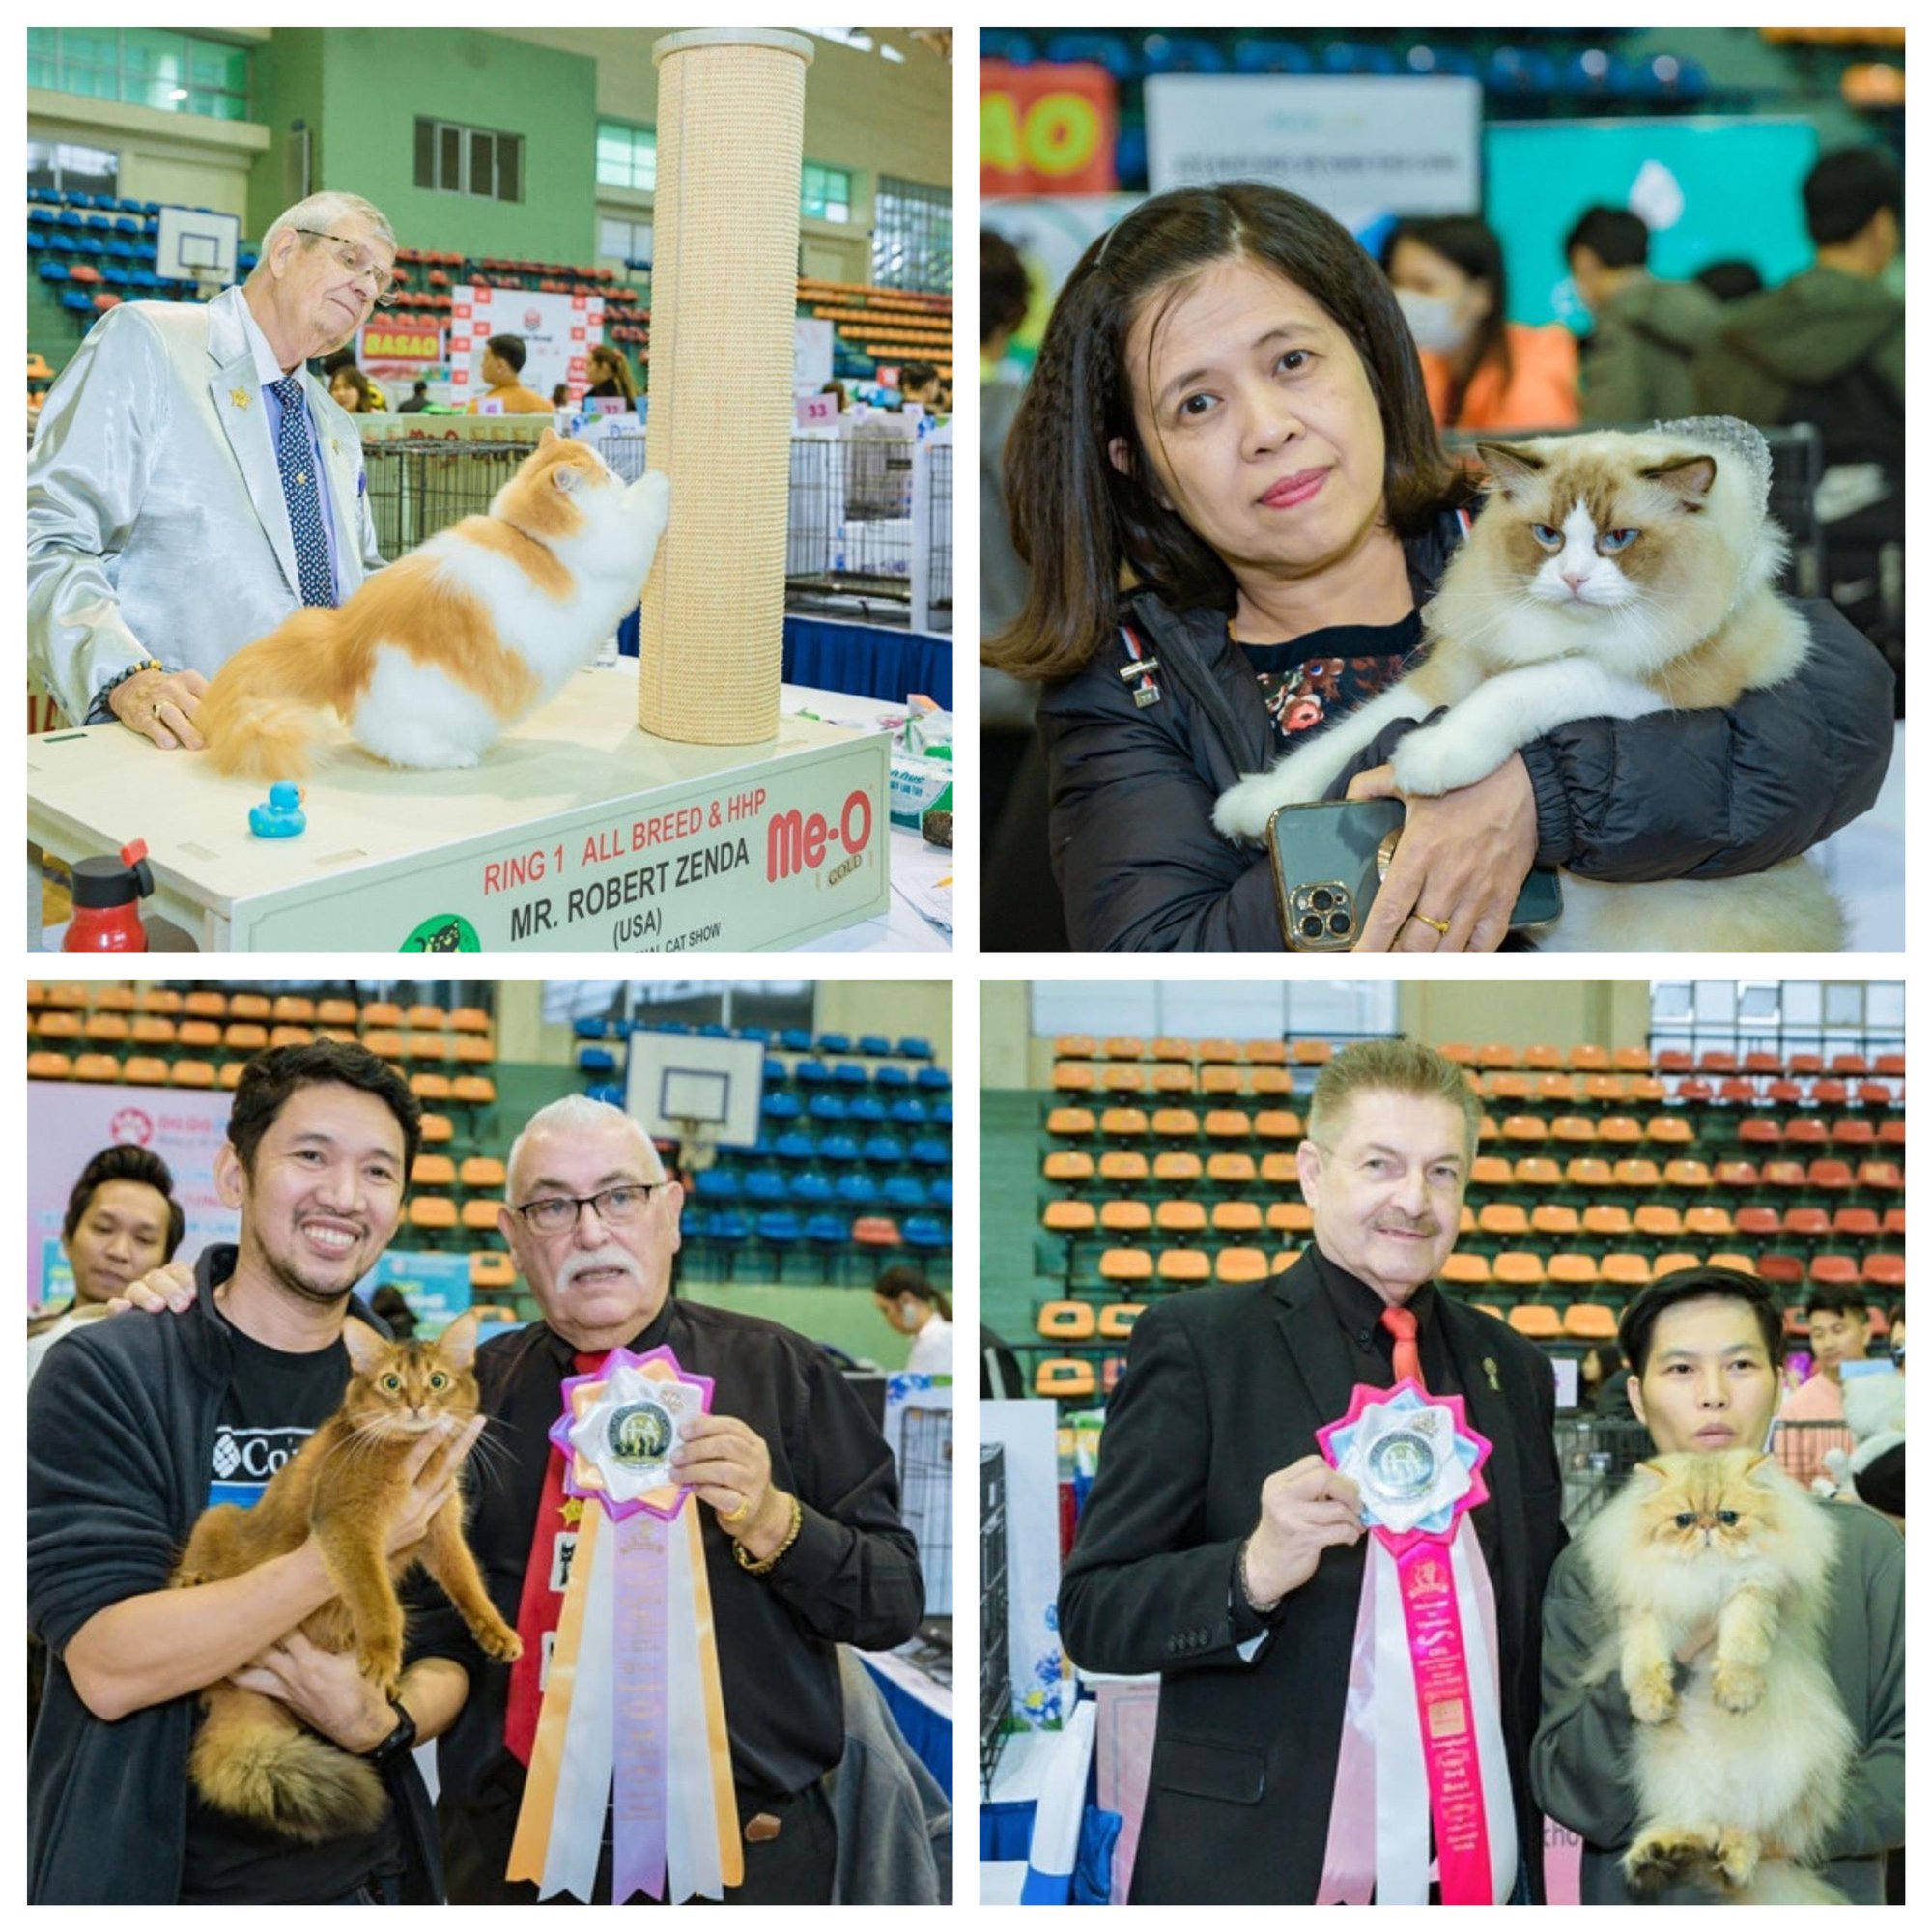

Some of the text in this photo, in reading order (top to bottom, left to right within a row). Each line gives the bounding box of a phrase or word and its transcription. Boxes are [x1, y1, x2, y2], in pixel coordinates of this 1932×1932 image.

[364, 332, 439, 357] BASAO
[808, 403, 827, 418] 33
[484, 787, 767, 896] RING 1 ALL BREED & HHP
[828, 853, 863, 886] GOLD
[510, 837, 750, 942] MR. ROBERT ZENDA
[612, 906, 663, 952] (USA)
[665, 933, 687, 953] CAT
[688, 921, 722, 947] SHOW
